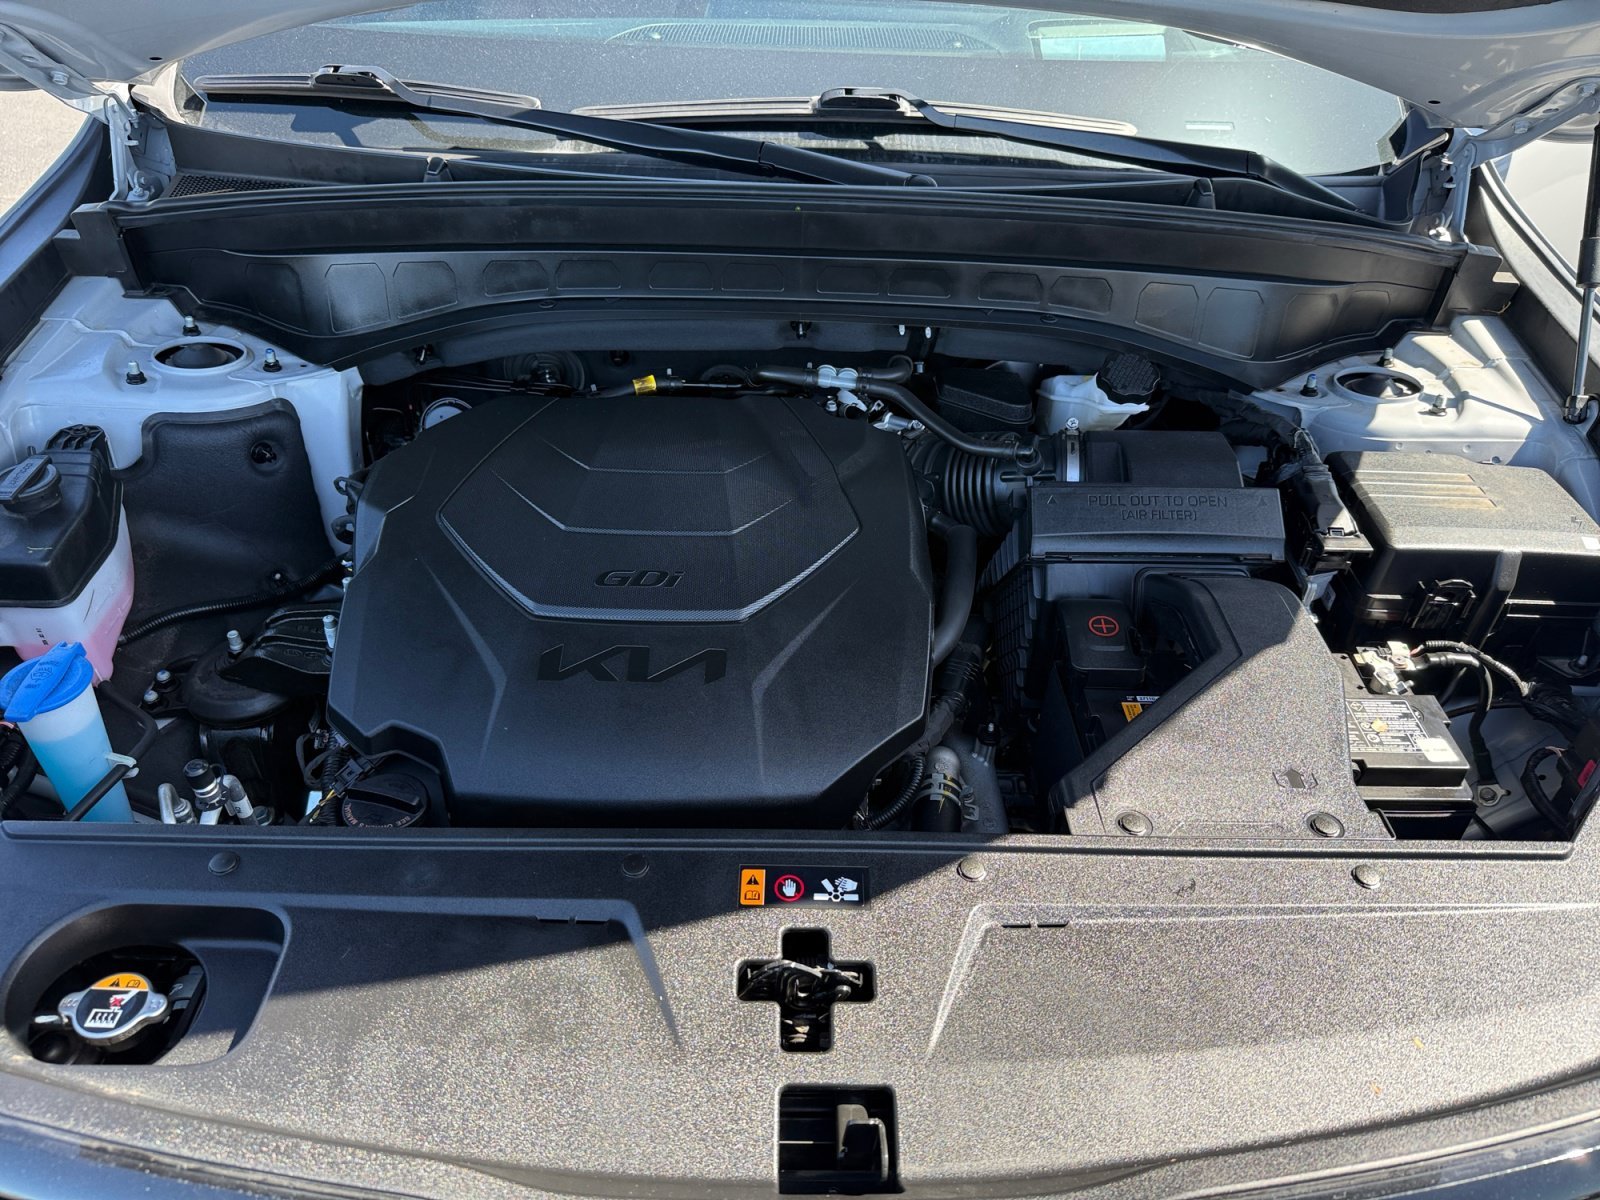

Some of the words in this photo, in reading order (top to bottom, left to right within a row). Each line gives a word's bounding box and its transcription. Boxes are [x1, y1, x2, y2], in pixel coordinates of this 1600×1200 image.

[1088, 495, 1126, 507] PULL
[1130, 495, 1160, 507] OUT
[1164, 495, 1184, 507] TO
[1187, 495, 1228, 508] OPEN
[595, 570, 686, 588] GDi
[537, 643, 727, 684] KIA
